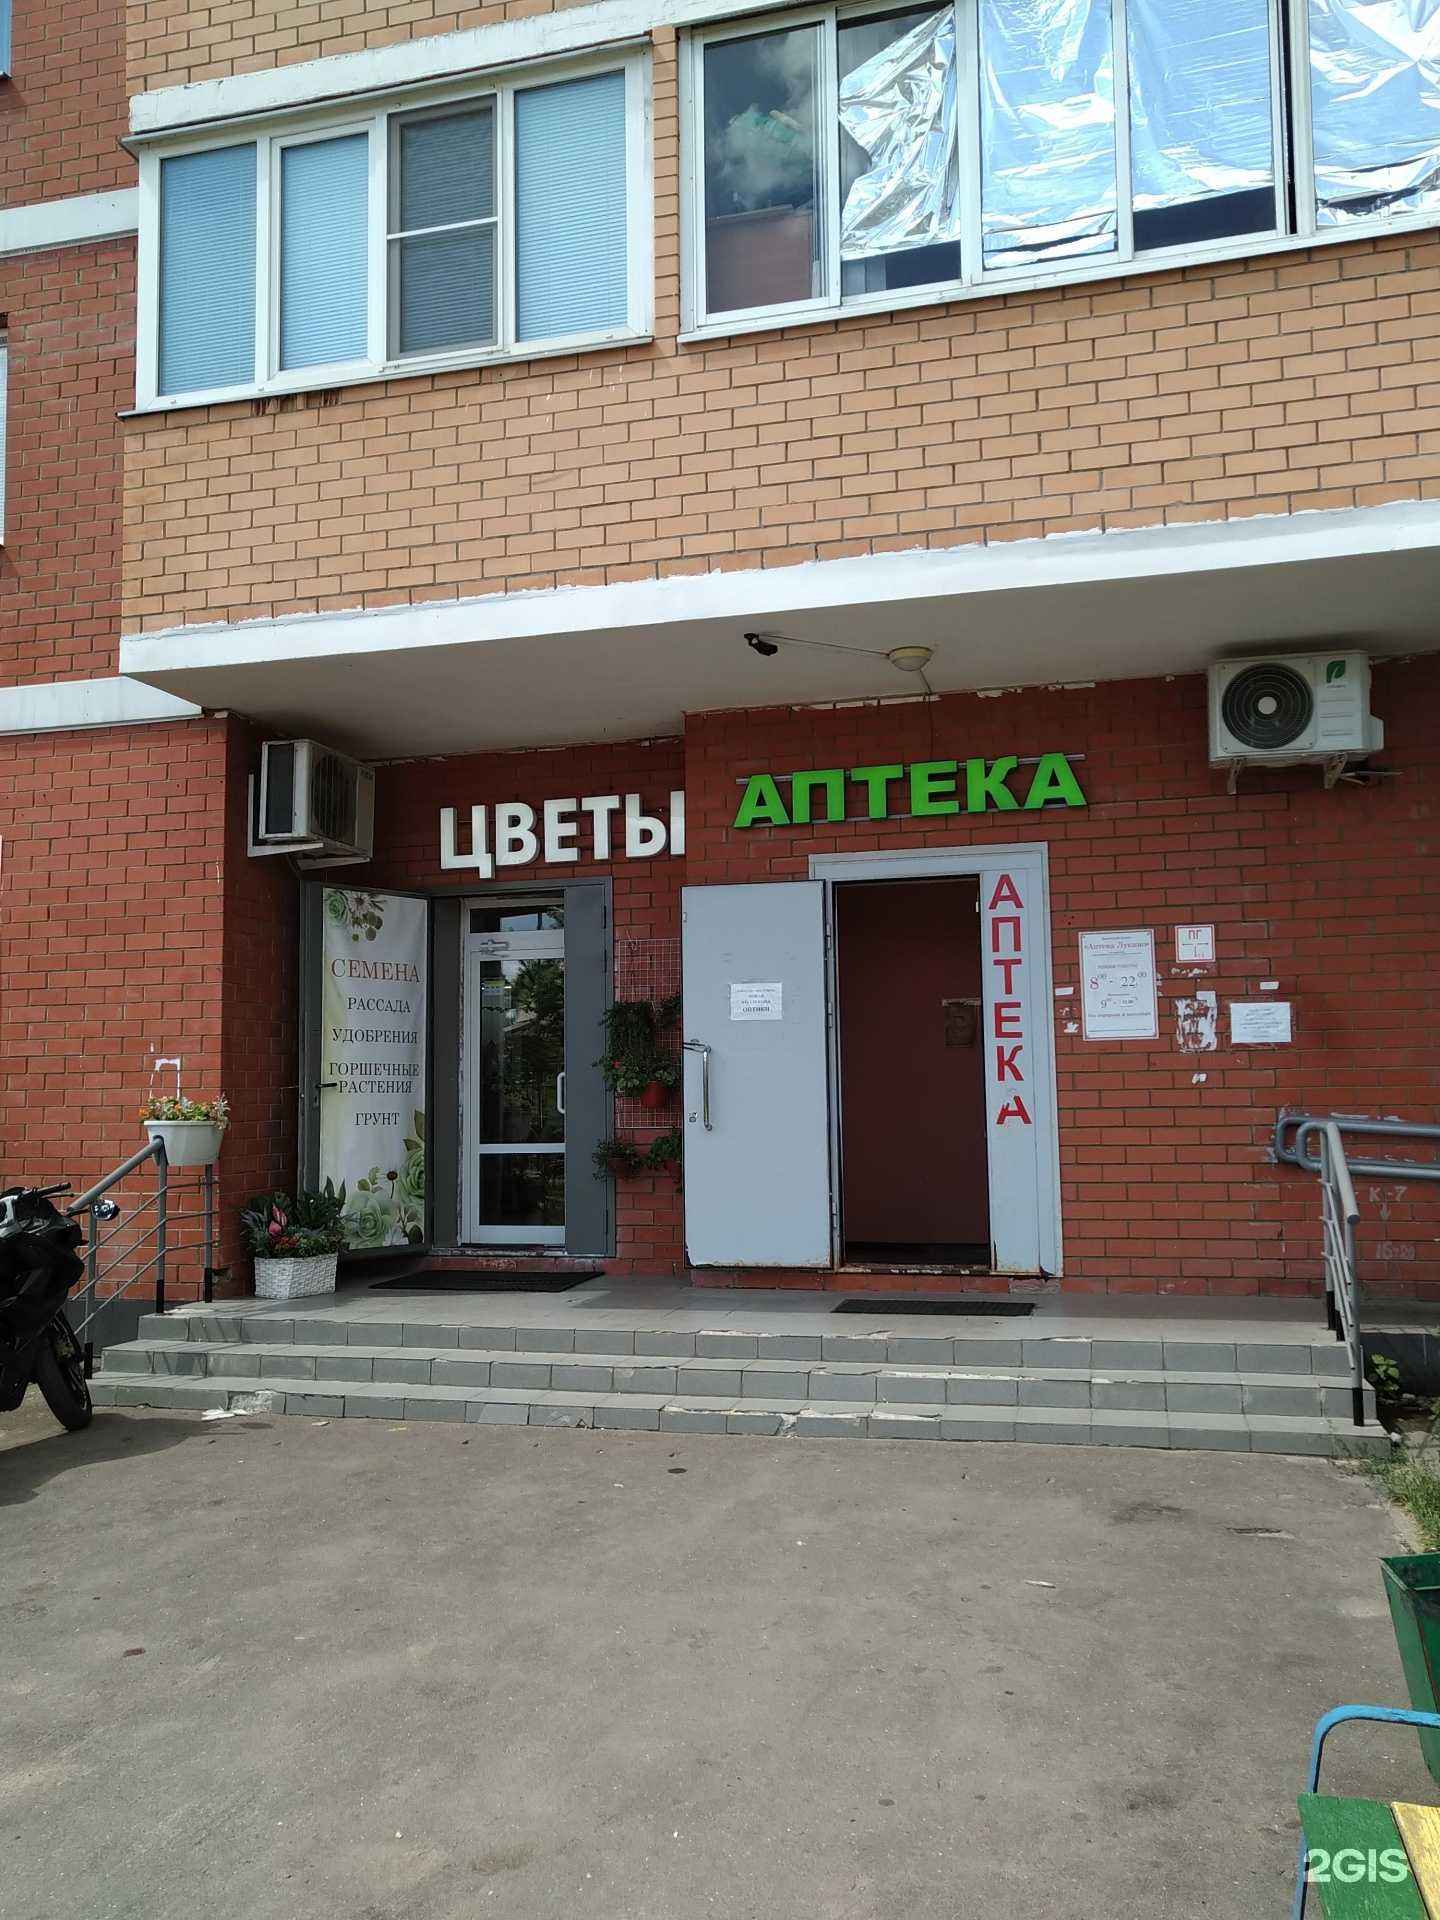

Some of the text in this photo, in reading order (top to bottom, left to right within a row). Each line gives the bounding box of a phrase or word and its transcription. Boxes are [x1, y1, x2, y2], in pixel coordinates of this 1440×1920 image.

[733, 753, 1086, 829] АПТЕКА
[440, 790, 685, 879] ЦВЕТЫ
[331, 958, 421, 983] СЕМЕНА
[347, 997, 411, 1013] РАССАДА
[988, 873, 1032, 1125] АПТЕКА
[332, 1028, 418, 1044] УДОБРЕНИЯ
[329, 1062, 420, 1077] ГОРШЕЧНЫЕ
[339, 1080, 412, 1094] РАСТЕНИЯ
[355, 1112, 400, 1126] ГРУНТ
